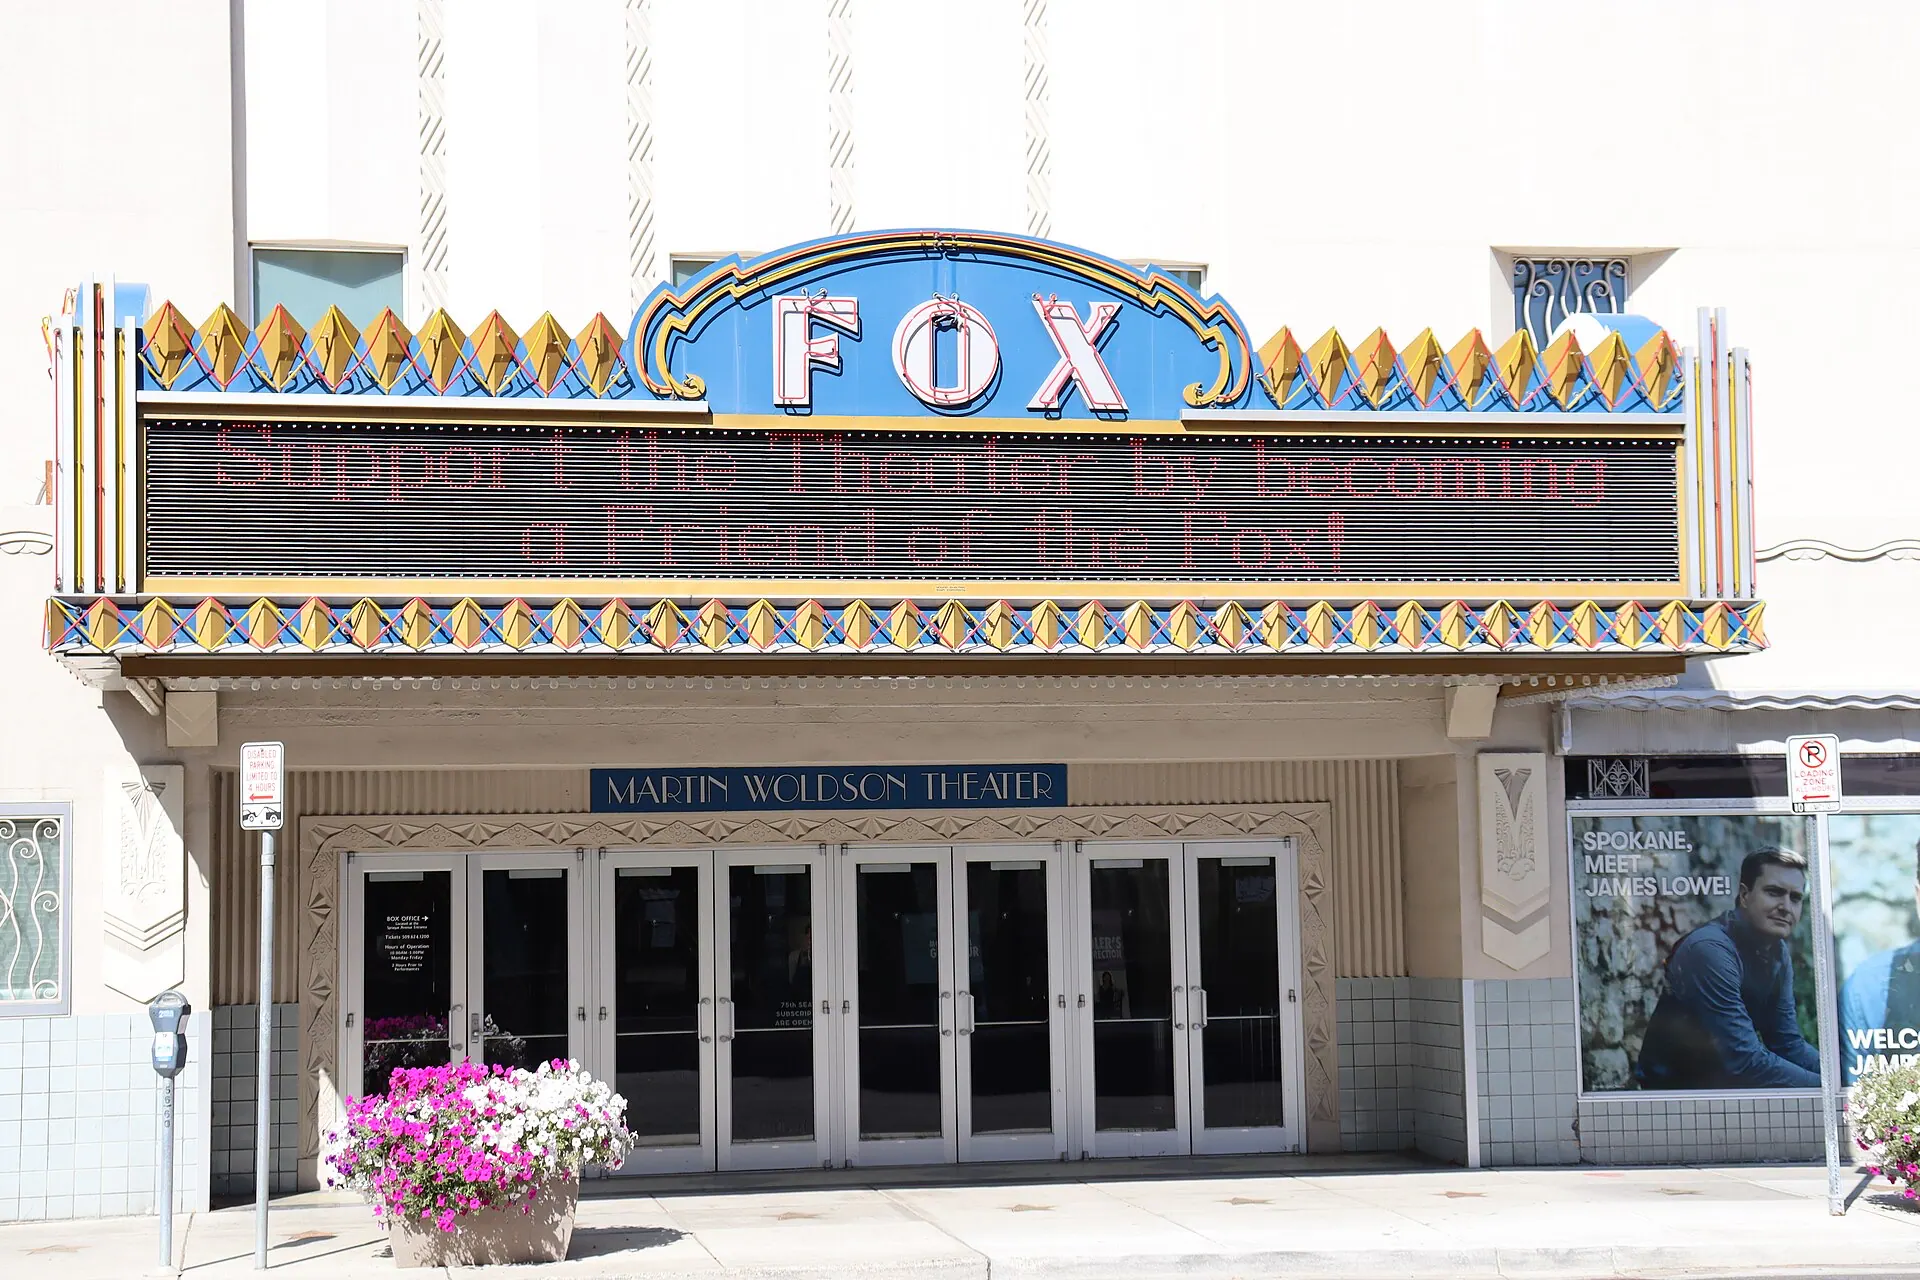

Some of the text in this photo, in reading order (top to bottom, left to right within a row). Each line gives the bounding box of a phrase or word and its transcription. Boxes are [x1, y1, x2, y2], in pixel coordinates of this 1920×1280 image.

[771, 292, 1130, 413] FOX
[216, 424, 1608, 507] Support the Theater by becoming
[521, 505, 1344, 573] a Friend of the Fox!
[247, 749, 277, 759] DISABLED
[249, 760, 275, 770] PARKING
[1794, 769, 1835, 778] LOADING
[246, 771, 278, 782] LIMITED TO
[1803, 777, 1827, 786] ZONE
[248, 783, 276, 792] 4 HOURS
[607, 771, 1054, 805] MARTIN WOLDSON THEATER
[1583, 831, 1693, 853] SPOKANE,
[1585, 854, 1641, 874] MEET
[1585, 876, 1731, 897] JAMES LOWE!
[1846, 1027, 1920, 1050] WELC
